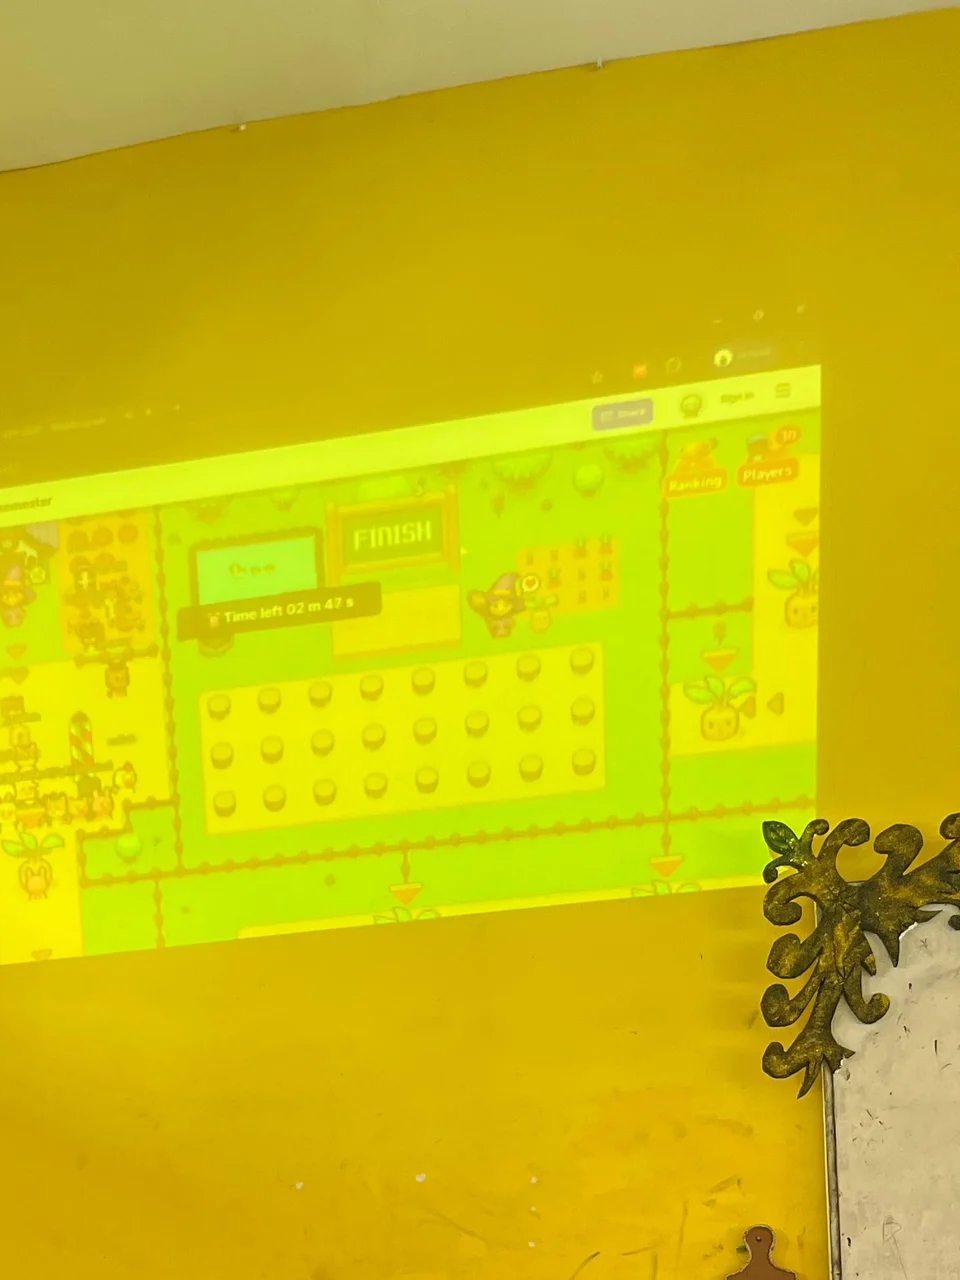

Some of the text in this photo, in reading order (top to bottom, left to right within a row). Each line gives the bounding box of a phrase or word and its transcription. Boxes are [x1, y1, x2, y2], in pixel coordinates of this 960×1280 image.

[668, 475, 723, 492] Ranking
[743, 466, 793, 482] Players
[353, 519, 433, 551] FINISH
[224, 597, 355, 624] Time left 02 m 47 s
